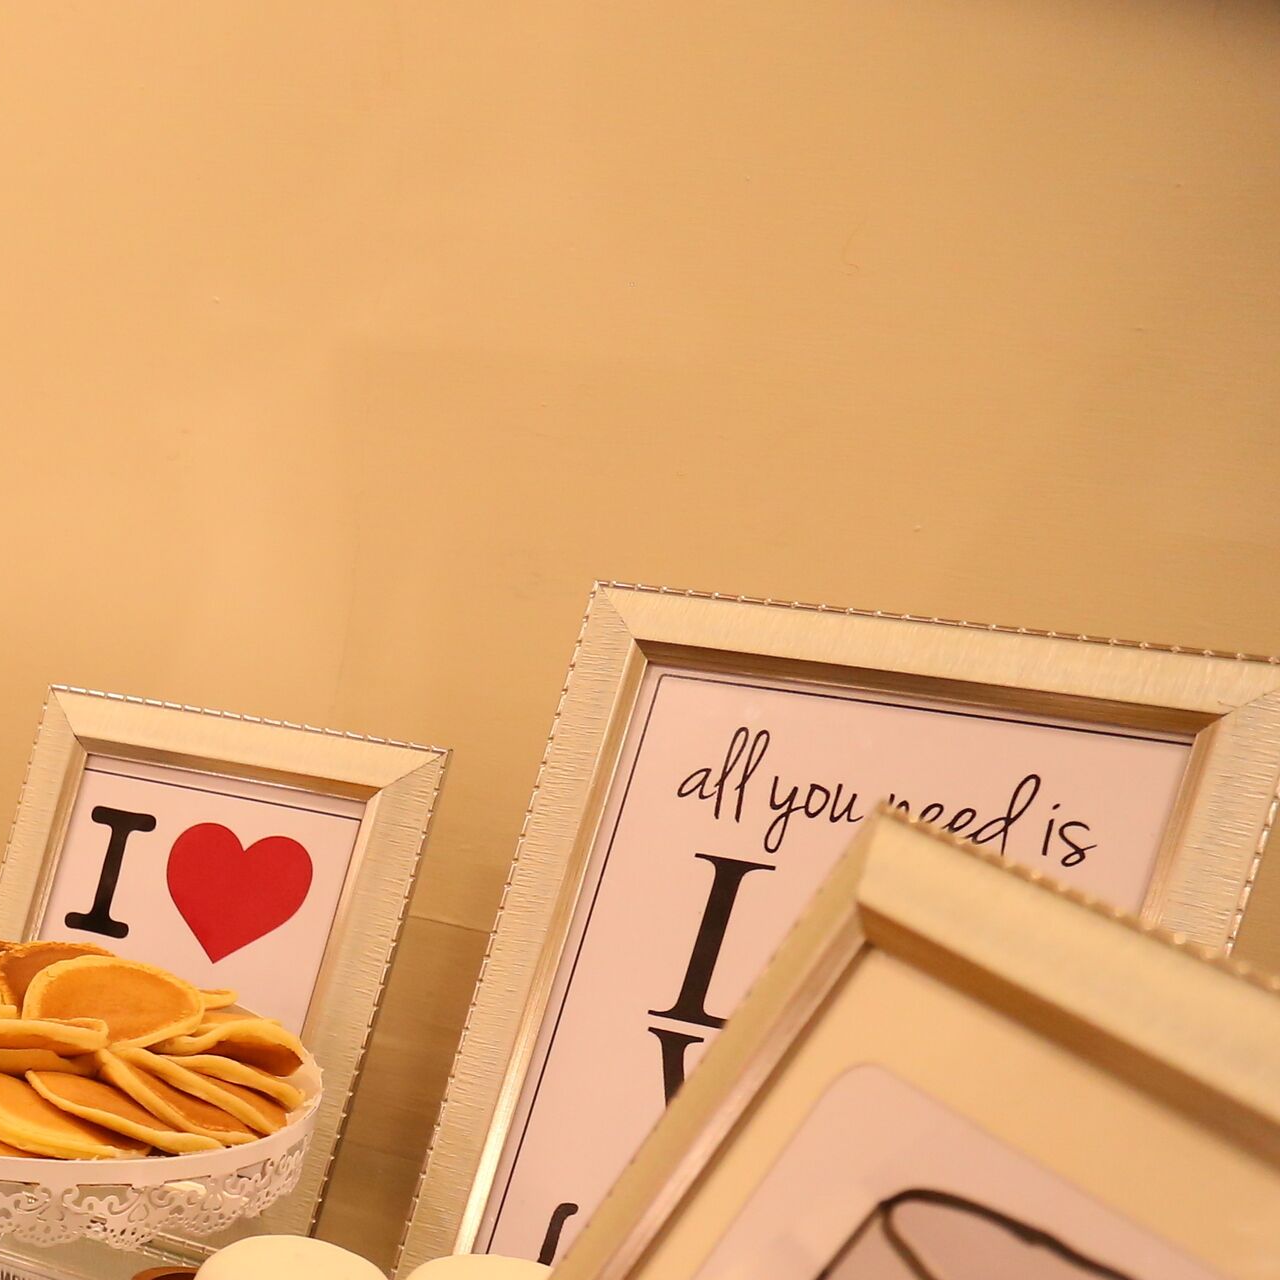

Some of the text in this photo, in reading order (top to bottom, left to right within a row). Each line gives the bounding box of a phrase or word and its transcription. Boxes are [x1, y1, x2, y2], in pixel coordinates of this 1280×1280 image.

[677, 726, 770, 823] all
[764, 775, 863, 853] you
[1041, 803, 1097, 867] is
[64, 805, 157, 939] I
